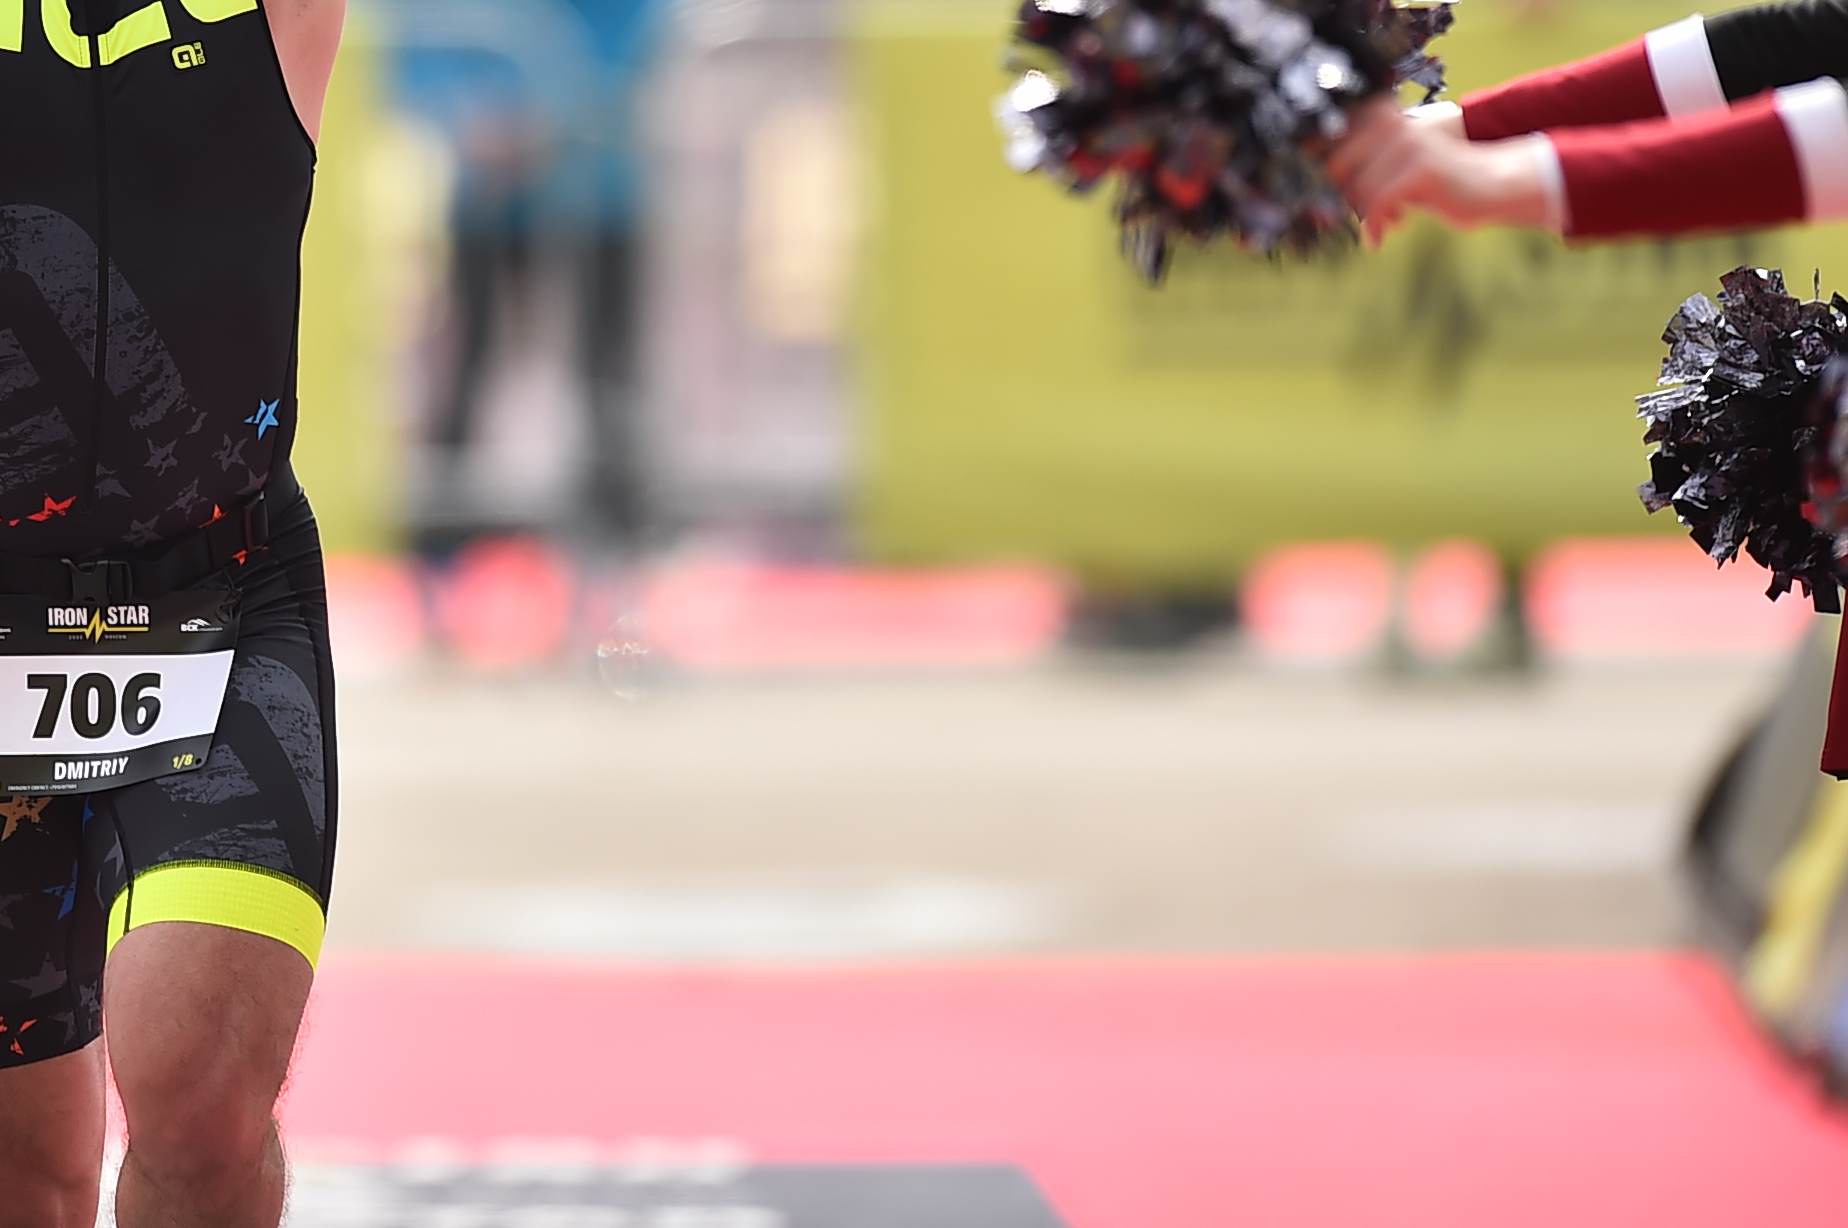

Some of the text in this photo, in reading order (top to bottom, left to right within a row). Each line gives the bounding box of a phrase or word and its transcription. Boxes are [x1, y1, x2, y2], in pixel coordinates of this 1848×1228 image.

[48, 605, 150, 626] IRON STAR
[26, 672, 162, 740] 706
[54, 756, 130, 781] DMITRIY
[171, 754, 194, 770] 1/8
